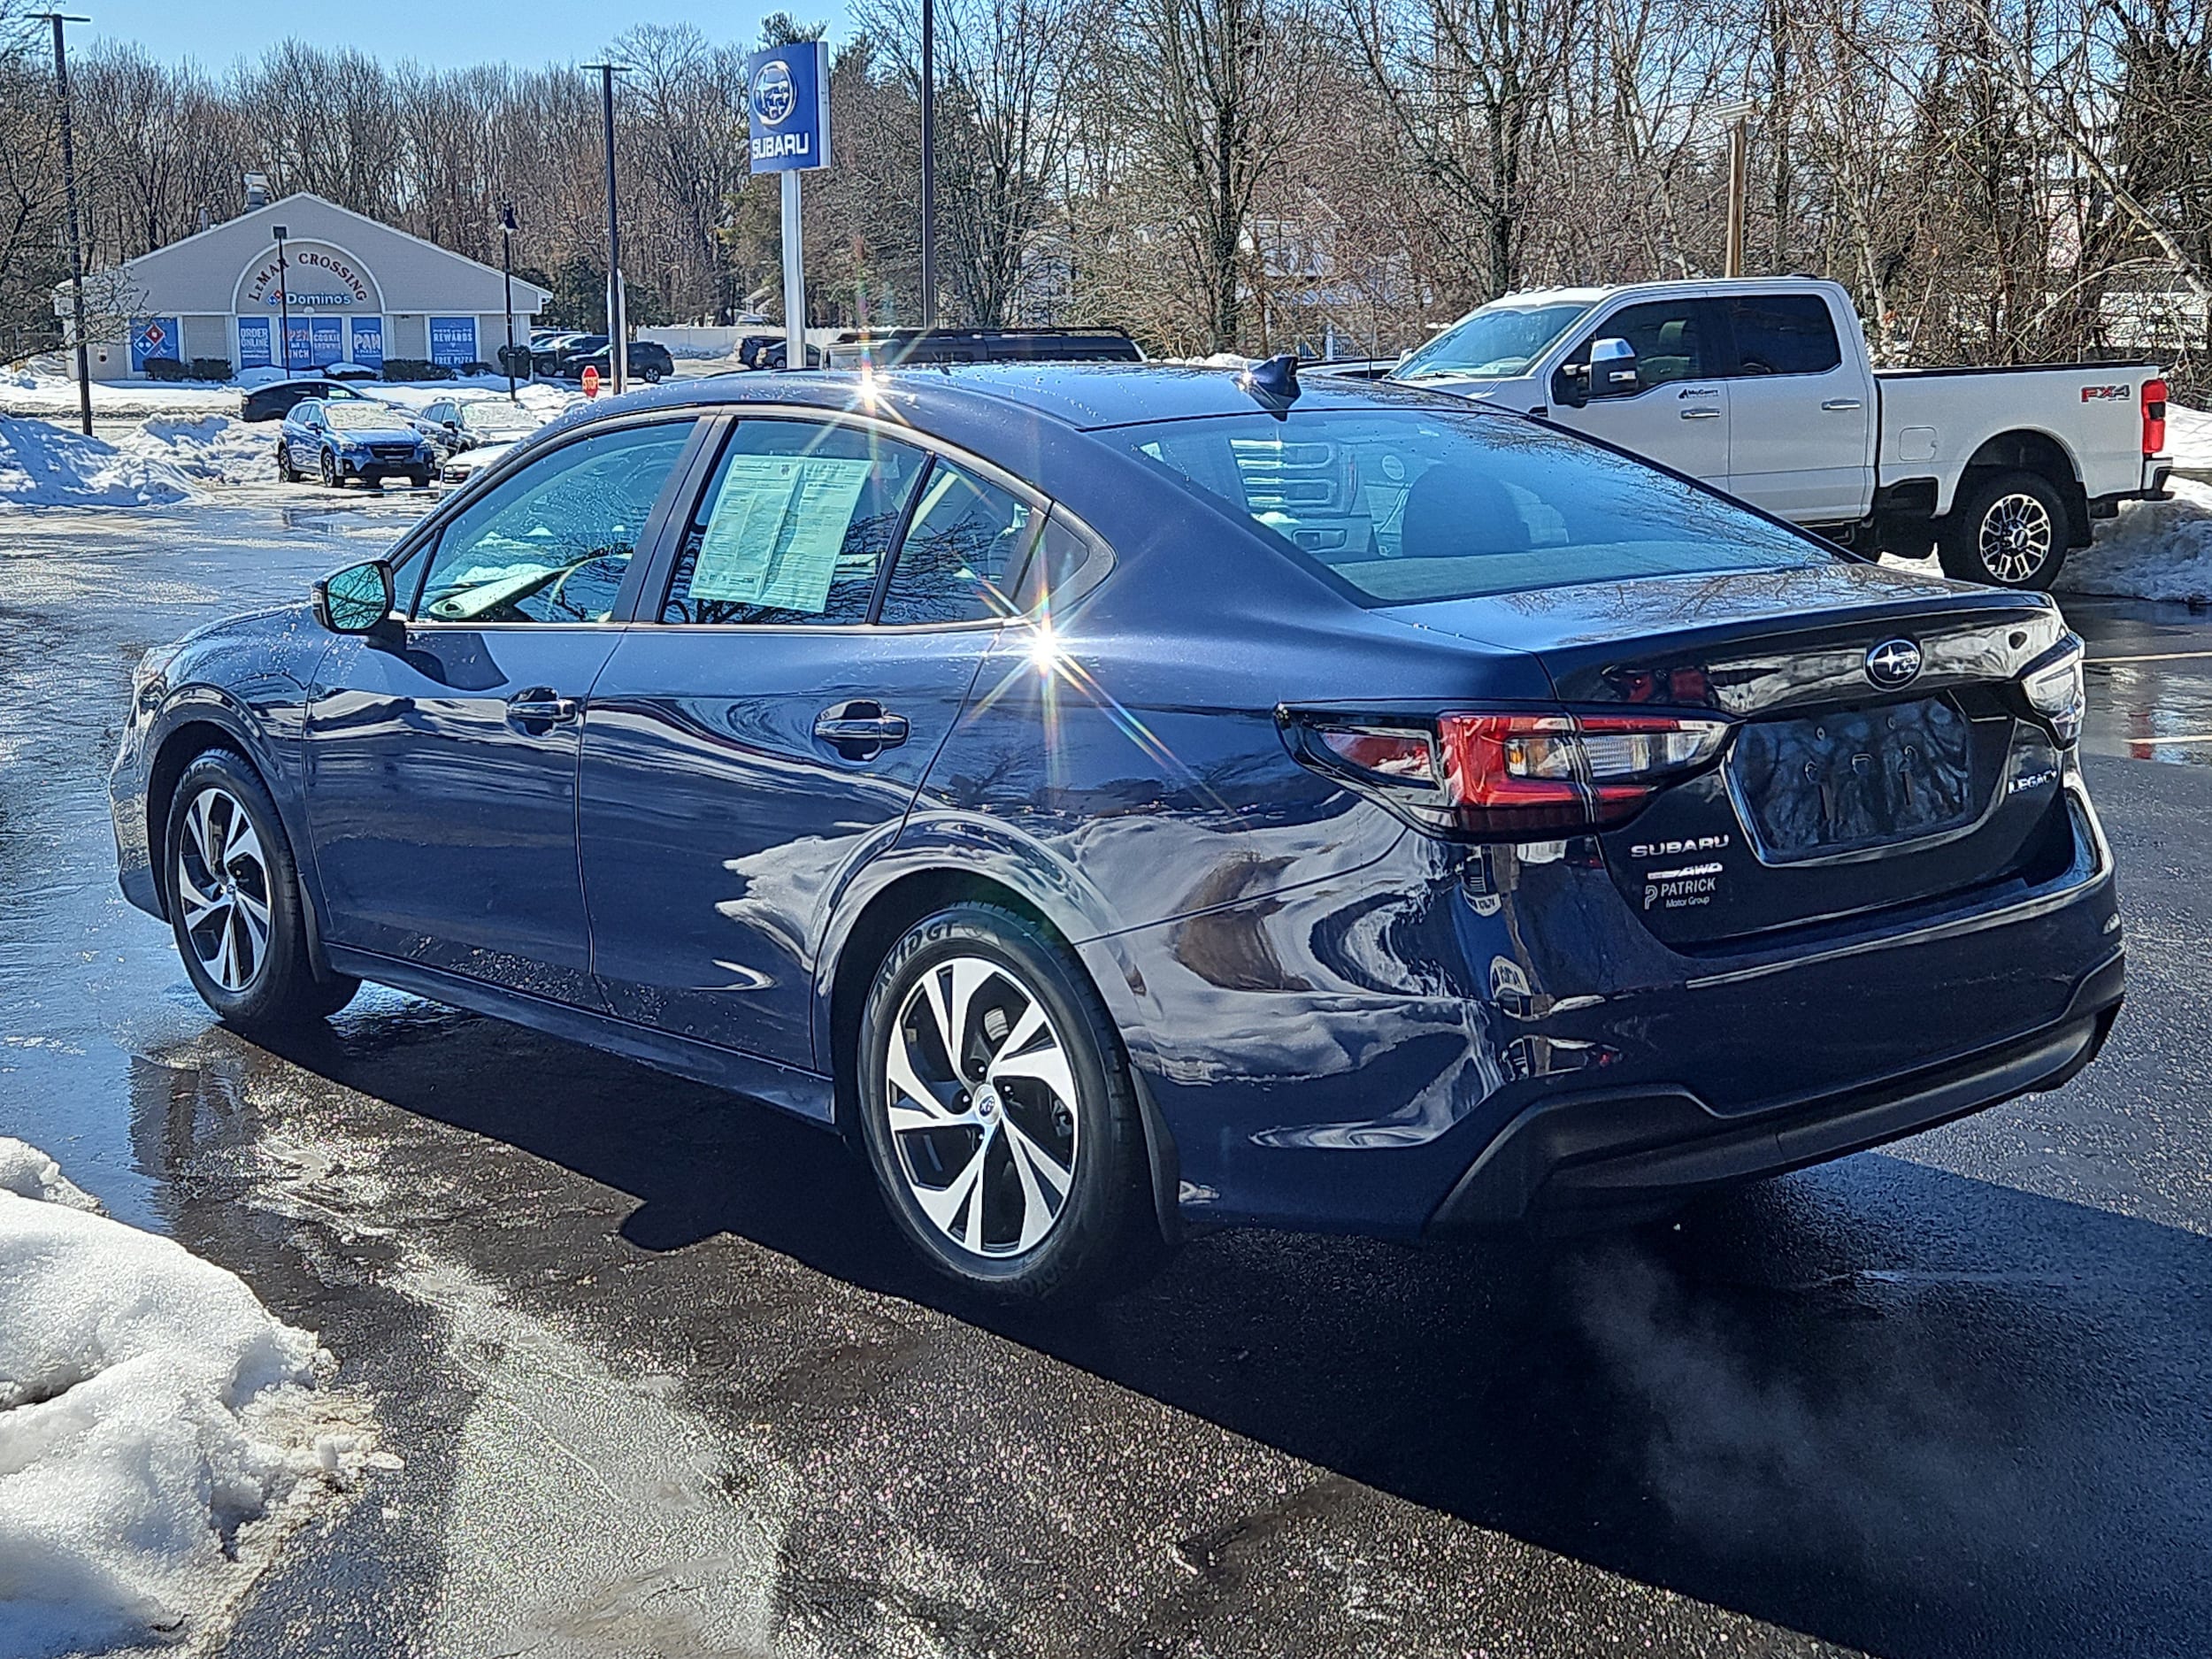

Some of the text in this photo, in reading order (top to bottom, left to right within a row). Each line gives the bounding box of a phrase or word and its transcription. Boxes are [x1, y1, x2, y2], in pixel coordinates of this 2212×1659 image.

[752, 132, 810, 160] SUBARU
[298, 252, 368, 302] CROSSING
[286, 292, 352, 305] Domino's
[240, 327, 268, 338] ORDER
[433, 333, 472, 342] REWARDS
[241, 337, 269, 348] ONLINE
[353, 333, 381, 350] PAN
[434, 356, 452, 365] FREE
[2081, 384, 2131, 403] FX4
[2008, 769, 2057, 794] LEGACY
[1631, 834, 1730, 857] SUBARU
[1678, 862, 1724, 877] AWD
[1660, 877, 1717, 897] PATRICK
[1665, 895, 1710, 909] Motor Group
[926, 920, 960, 941] GT
